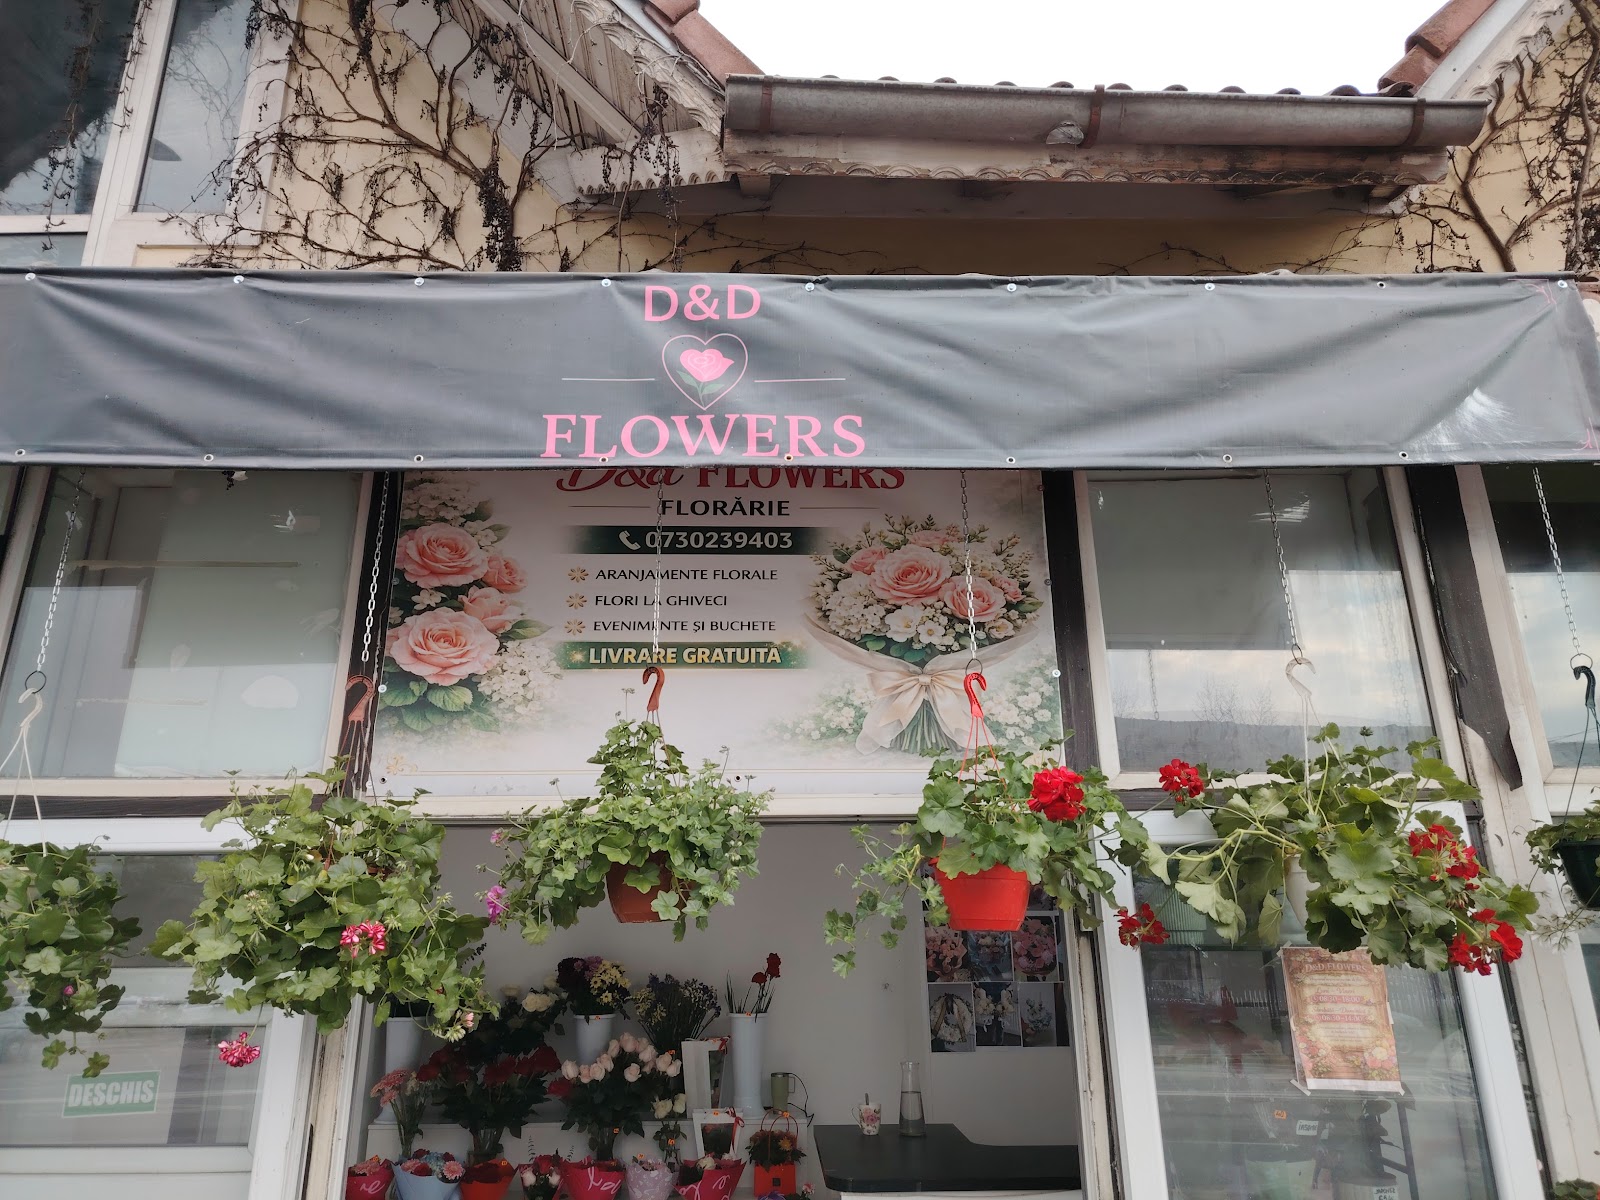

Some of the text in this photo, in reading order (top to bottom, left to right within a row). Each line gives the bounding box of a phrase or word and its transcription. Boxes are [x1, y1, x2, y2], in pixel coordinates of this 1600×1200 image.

[644, 284, 761, 322] D&D
[540, 414, 866, 458] FLOWERS
[661, 497, 790, 516] FLORĂRIE
[645, 531, 793, 550] 0730239403
[595, 569, 778, 582] ARANJAMENTE FLORALE
[595, 595, 727, 606] FLORI LA GHIVECI
[710, 620, 776, 632] BUCHETE
[589, 647, 678, 664] LIVRARE
[1327, 962, 1368, 971] FLOWERS
[68, 1079, 154, 1107] DESCHIS
